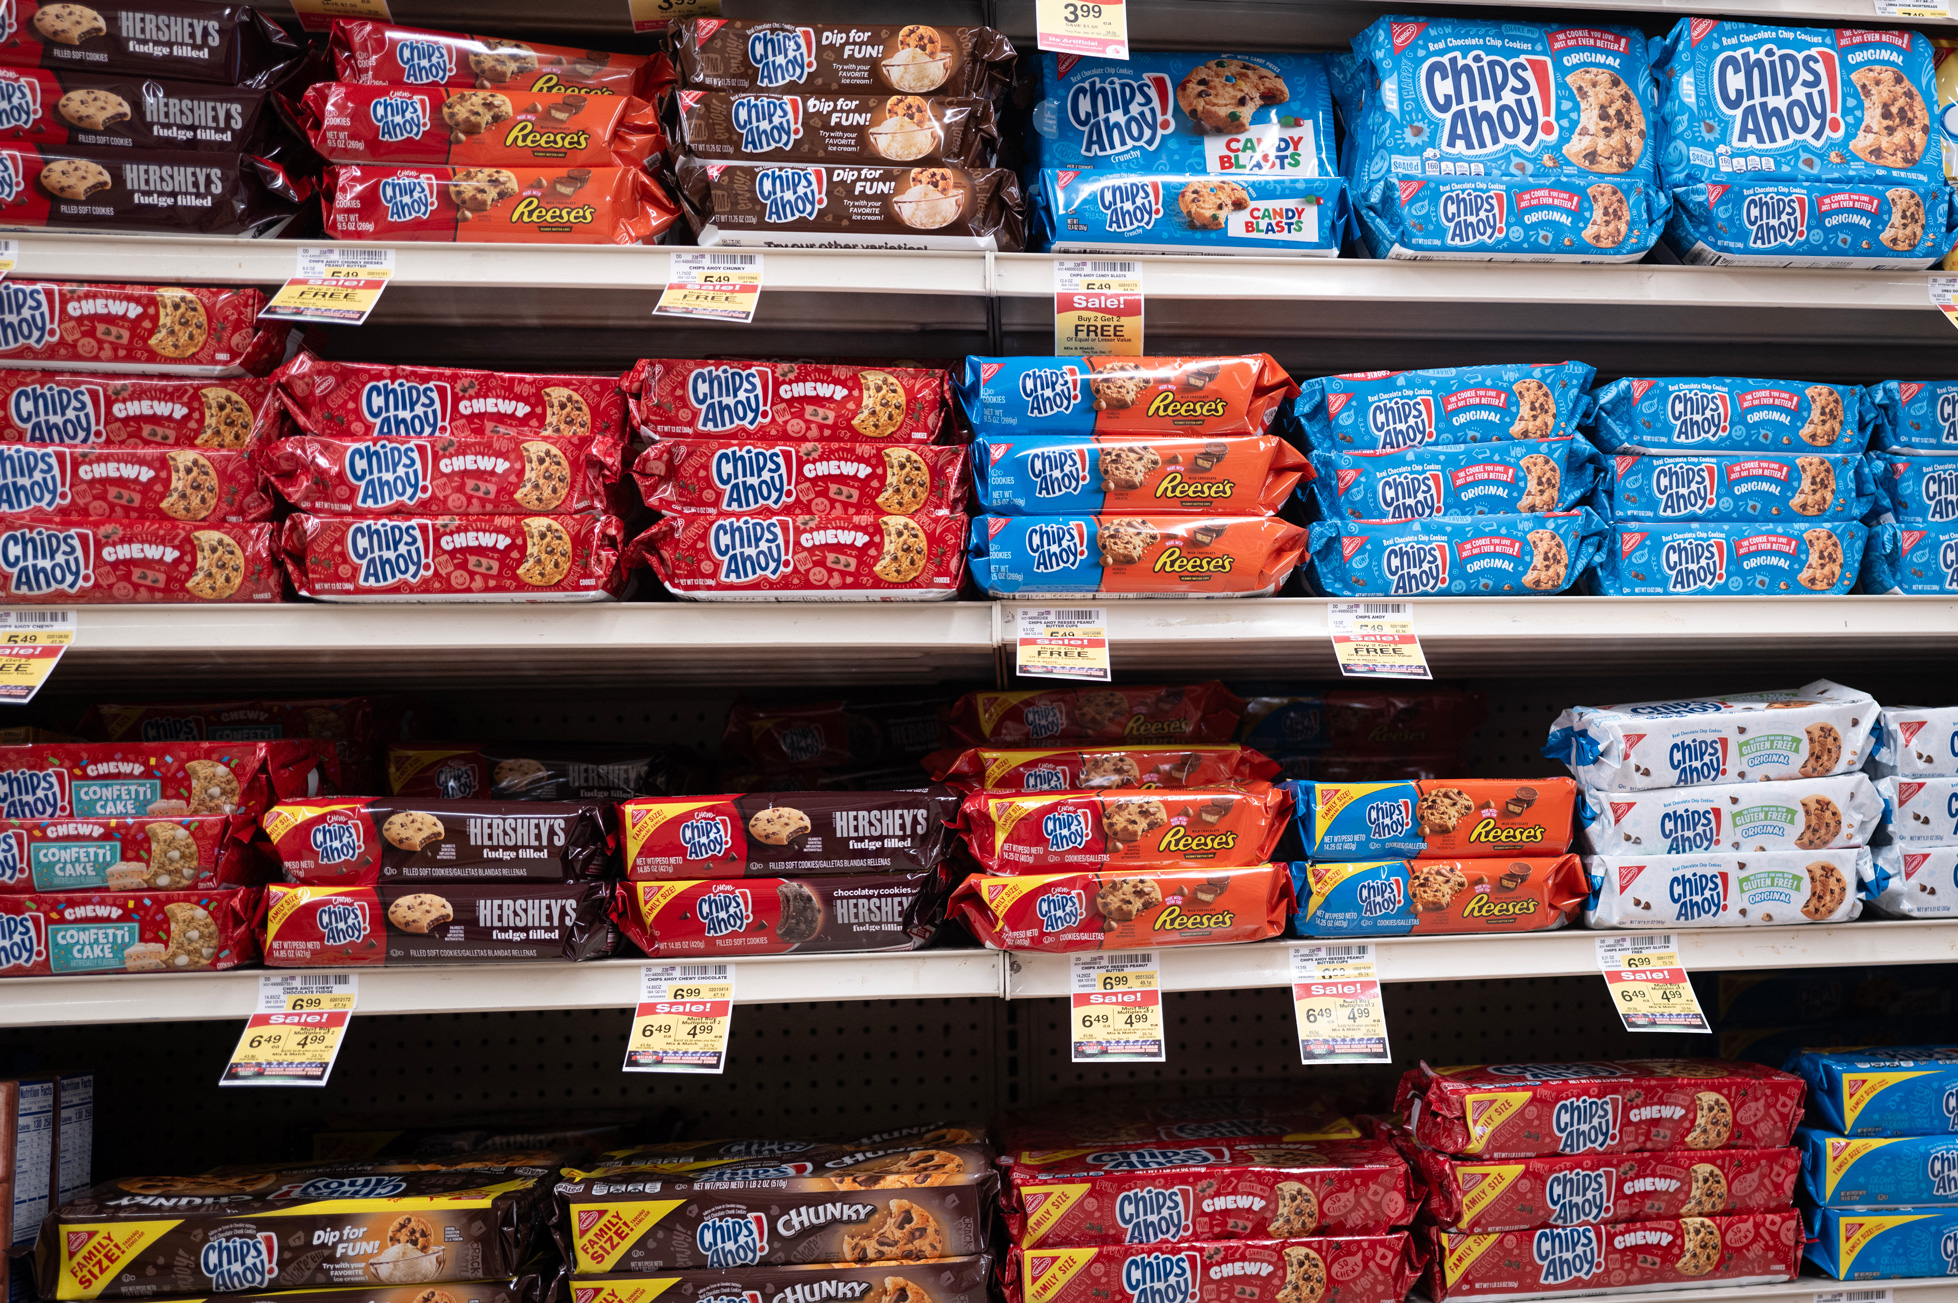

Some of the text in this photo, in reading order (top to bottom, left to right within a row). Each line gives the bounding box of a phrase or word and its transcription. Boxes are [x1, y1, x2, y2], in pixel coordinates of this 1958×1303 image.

[121, 11, 220, 46] HERSHEY'S
[821, 29, 871, 46] Dip for
[1427, 36, 1532, 52] Real Chocolate Chip Cookies
[128, 41, 209, 60] fudge filled
[843, 45, 884, 59] FUN!
[1562, 52, 1621, 69] ORIGINAL
[838, 70, 869, 78] FAVORITE
[1718, 47, 1823, 111] Chips
[1425, 53, 1531, 115] Chips
[372, 97, 419, 122] Chips
[1070, 75, 1154, 130] Chips
[325, 117, 351, 126] COOKIES
[505, 121, 592, 151] Reese's
[1111, 149, 1141, 165] Crunchy
[125, 164, 223, 196] HERSHEY'S
[757, 169, 813, 200] Chips
[1250, 207, 1306, 221] CANDY
[1524, 211, 1573, 227] ORIGINAL
[1244, 220, 1304, 236] BLASTS
[67, 299, 144, 319] CHEWY
[1073, 295, 1125, 309] Sale!
[1078, 315, 1092, 323] Buy
[1075, 324, 1125, 337] FREE
[692, 368, 758, 401] Chips
[1147, 389, 1229, 418] Reese's
[1669, 394, 1718, 422] Chips
[1452, 411, 1501, 427] ORIGINAL
[1747, 411, 1791, 426] ORIGINAL
[352, 521, 419, 554] Chips
[440, 531, 512, 550] CHEWY
[101, 544, 180, 563] CHEWY
[1353, 647, 1404, 655] FREE
[1742, 738, 1797, 755] GLUTEN FREE!
[1747, 753, 1791, 767] ORIGINAL
[96, 800, 136, 815] CAKE
[1367, 803, 1403, 824] Chips
[469, 818, 566, 847] HERSHEY'S
[836, 809, 928, 839] HERSHEY'S
[1470, 818, 1545, 843] Reese's
[1159, 825, 1238, 852] Reese's
[484, 848, 549, 860] fudge filled
[833, 886, 911, 897] chocolatey cookies
[1670, 876, 1719, 904] Chips
[64, 906, 122, 921] CHEWY
[1620, 970, 1670, 980] Sale!
[1310, 983, 1362, 995] Sale!
[1089, 992, 1142, 1004] Sale!
[655, 1003, 712, 1013] Sale!
[269, 1013, 329, 1024] Sale!
[1629, 1105, 1686, 1122] CHEWY
[1120, 1188, 1181, 1219] Chips
[1202, 1196, 1267, 1213] CHEWY
[777, 1202, 875, 1238] CHUNKY
[581, 1210, 623, 1256] FAMILY
[336, 1241, 380, 1258] FUN!
[589, 1221, 636, 1264] SIZE!
[1536, 1229, 1594, 1259] Chips
[201, 1238, 263, 1272] Chips
